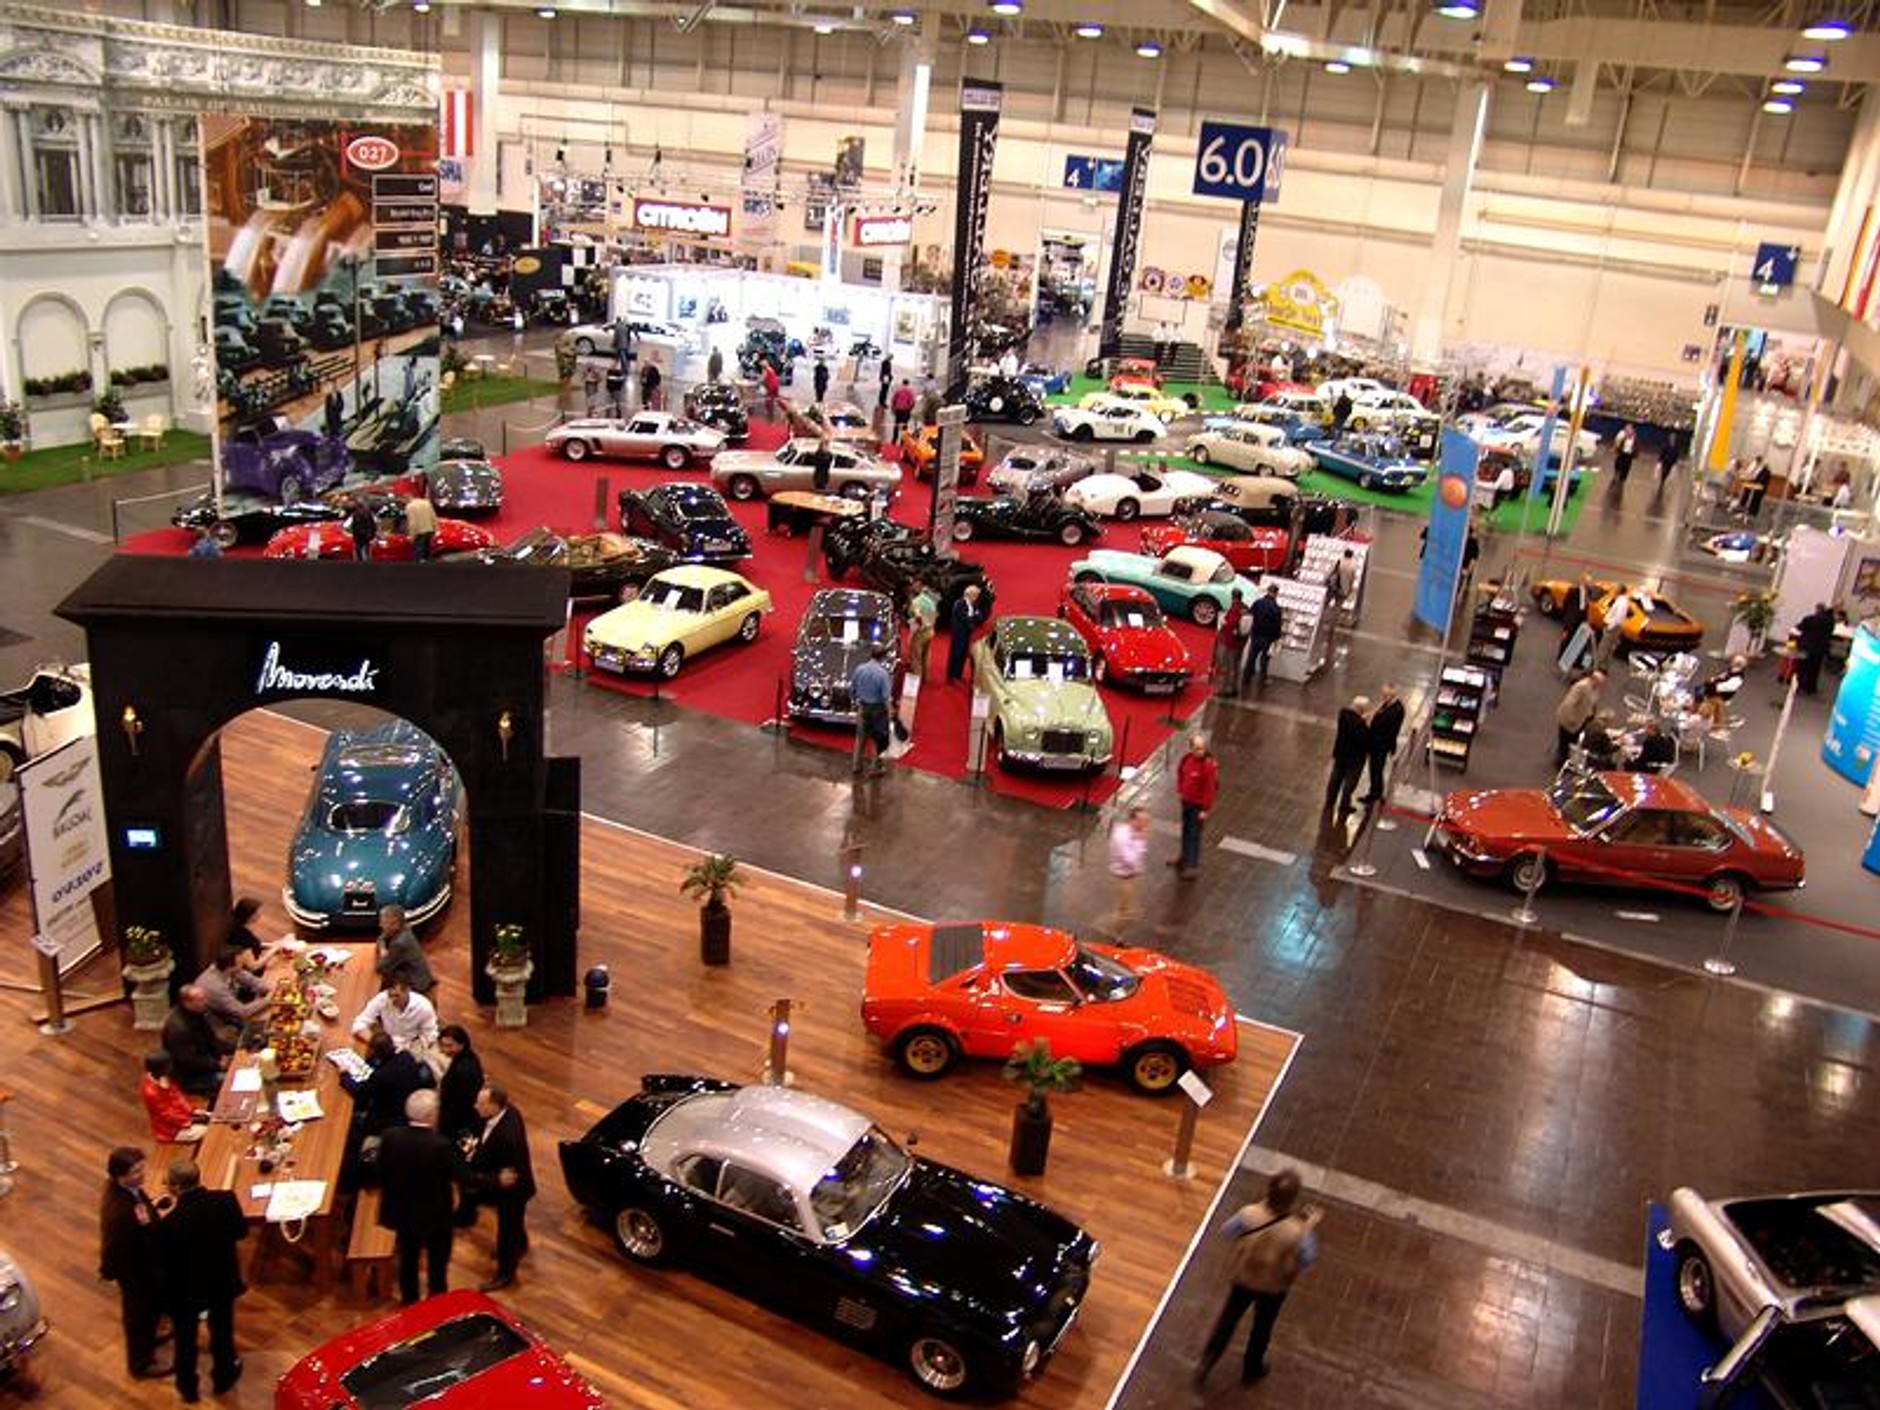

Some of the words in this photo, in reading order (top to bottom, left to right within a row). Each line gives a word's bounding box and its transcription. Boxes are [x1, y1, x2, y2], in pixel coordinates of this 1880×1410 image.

[1200, 136, 1263, 187] 6.0
[1067, 169, 1079, 187] 4
[1756, 257, 1773, 280] 4
